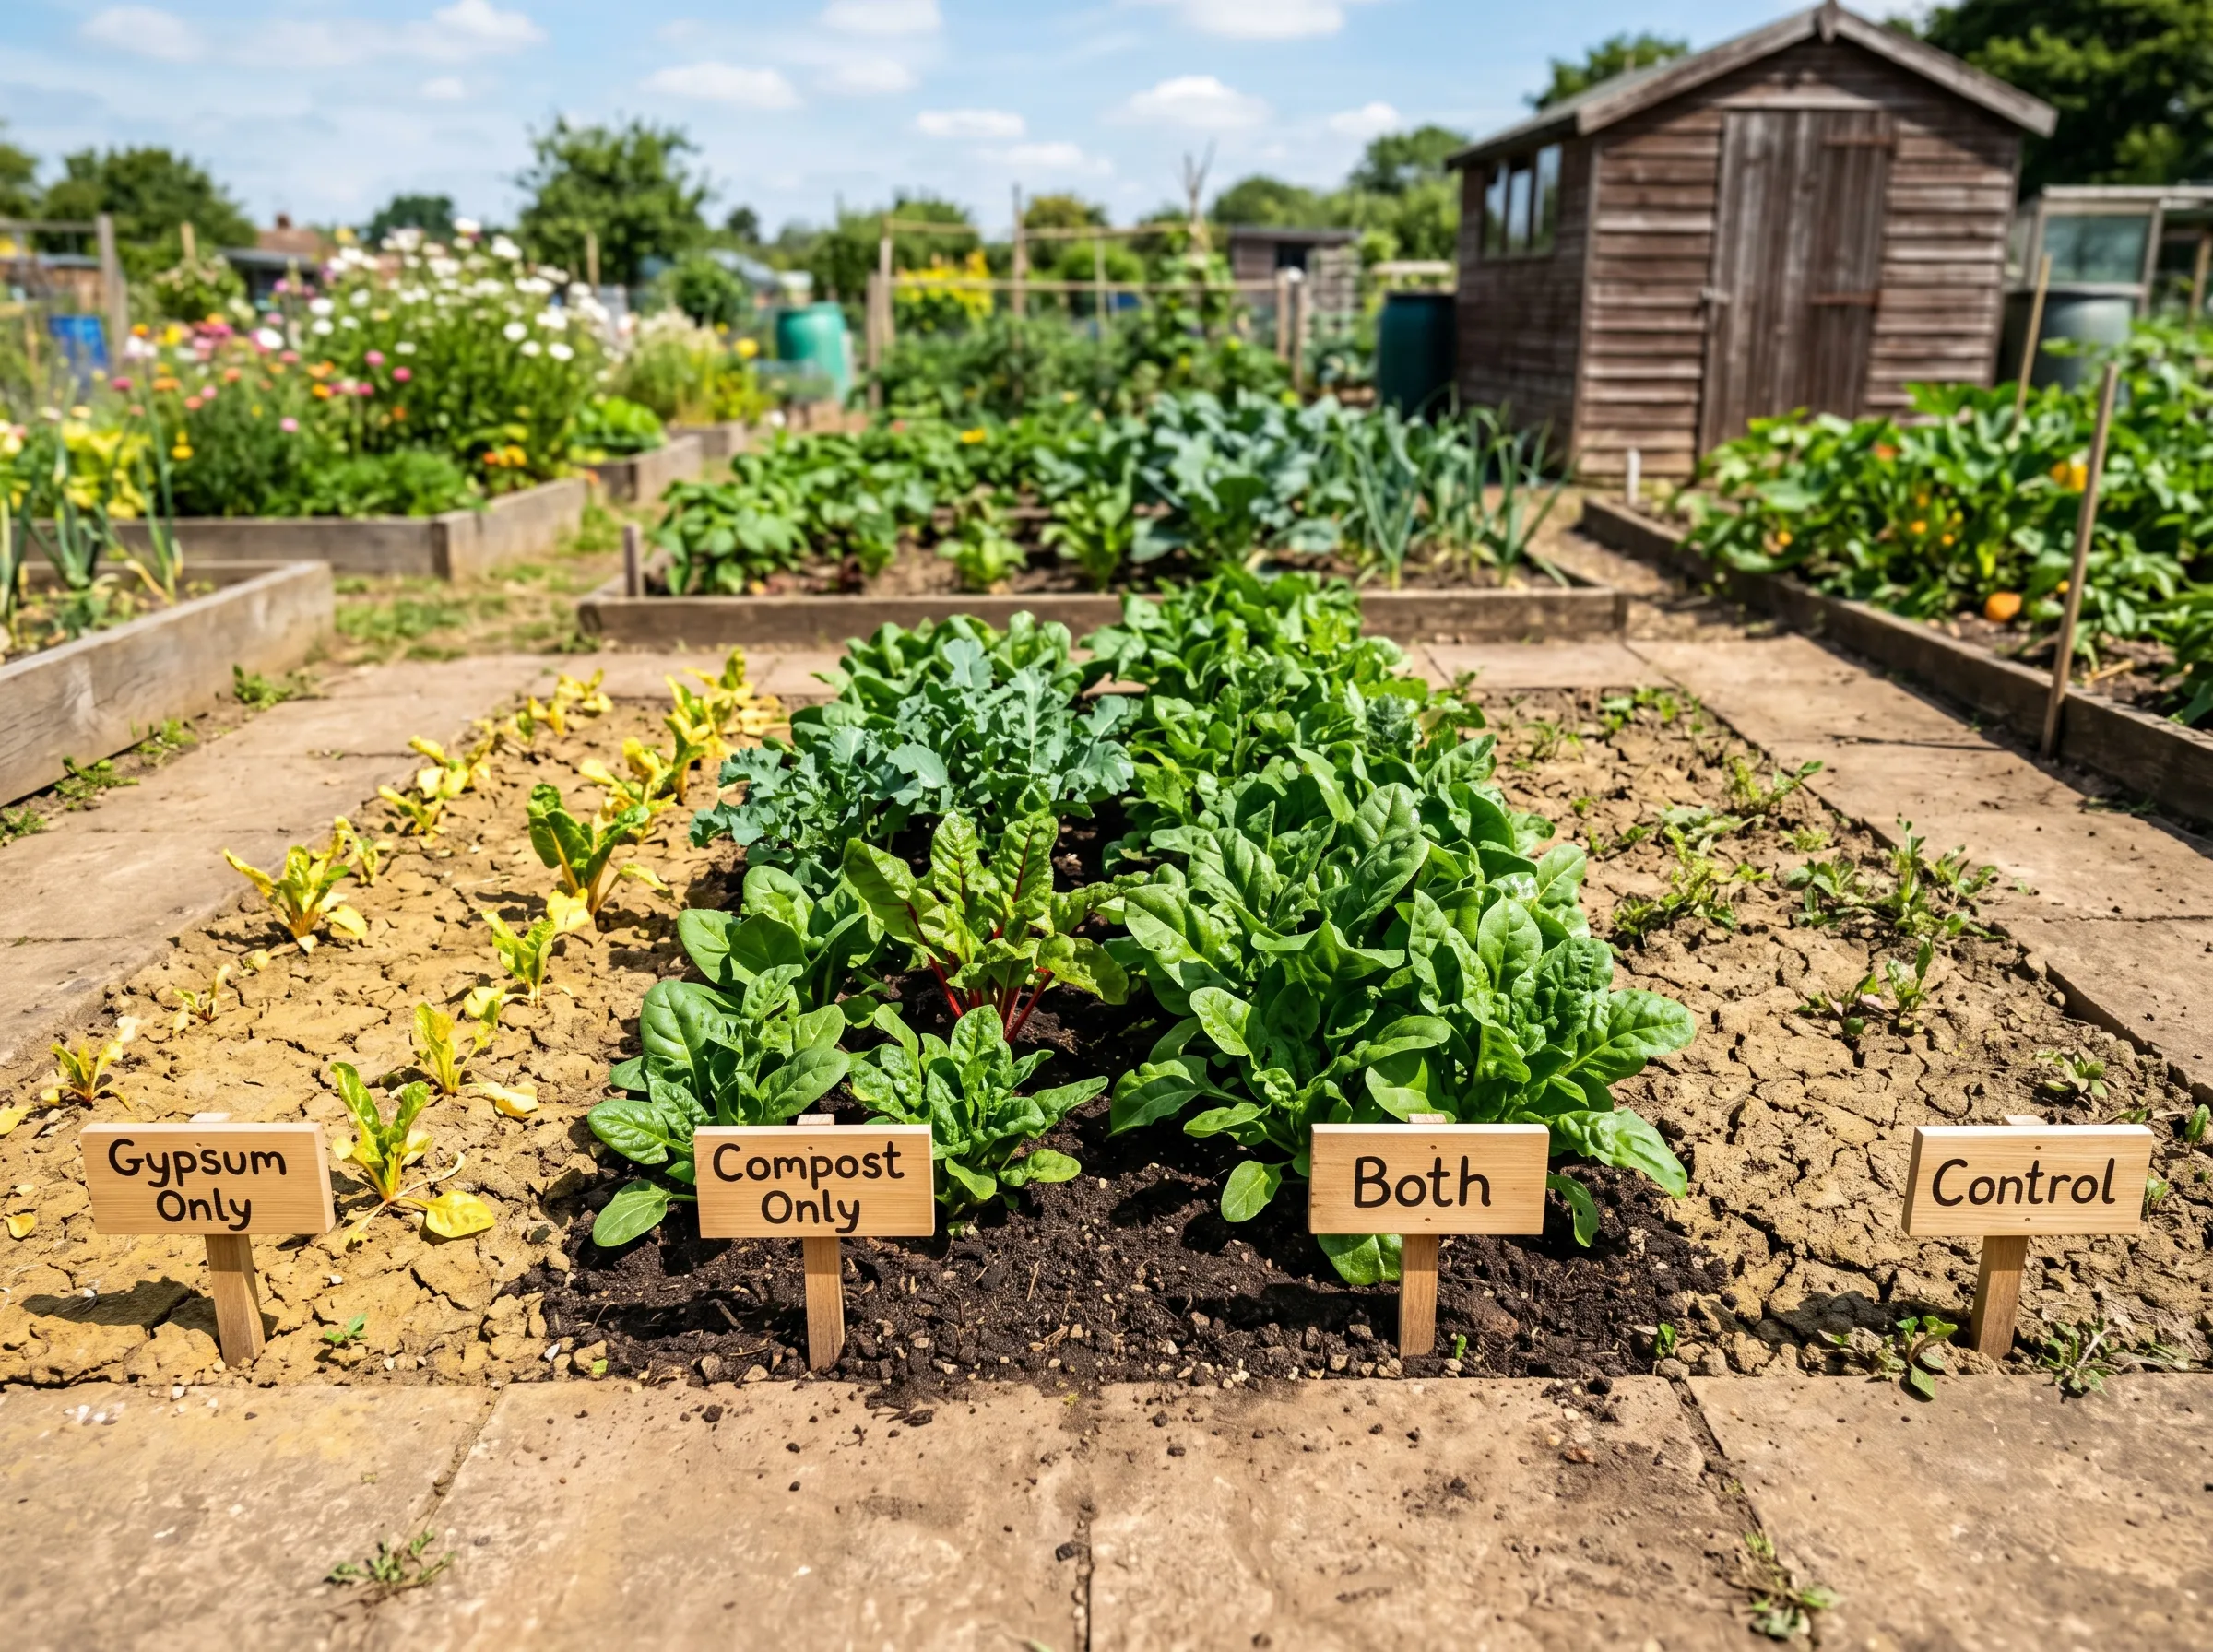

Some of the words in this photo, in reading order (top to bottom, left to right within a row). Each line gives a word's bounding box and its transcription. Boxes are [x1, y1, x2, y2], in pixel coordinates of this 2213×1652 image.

[108, 1138, 287, 1188] Gypsum
[713, 1140, 905, 1191] Compost
[1354, 1155, 1492, 1209] Both
[1932, 1157, 2116, 1207] Control
[156, 1187, 252, 1232] Only
[761, 1188, 860, 1234] Only
